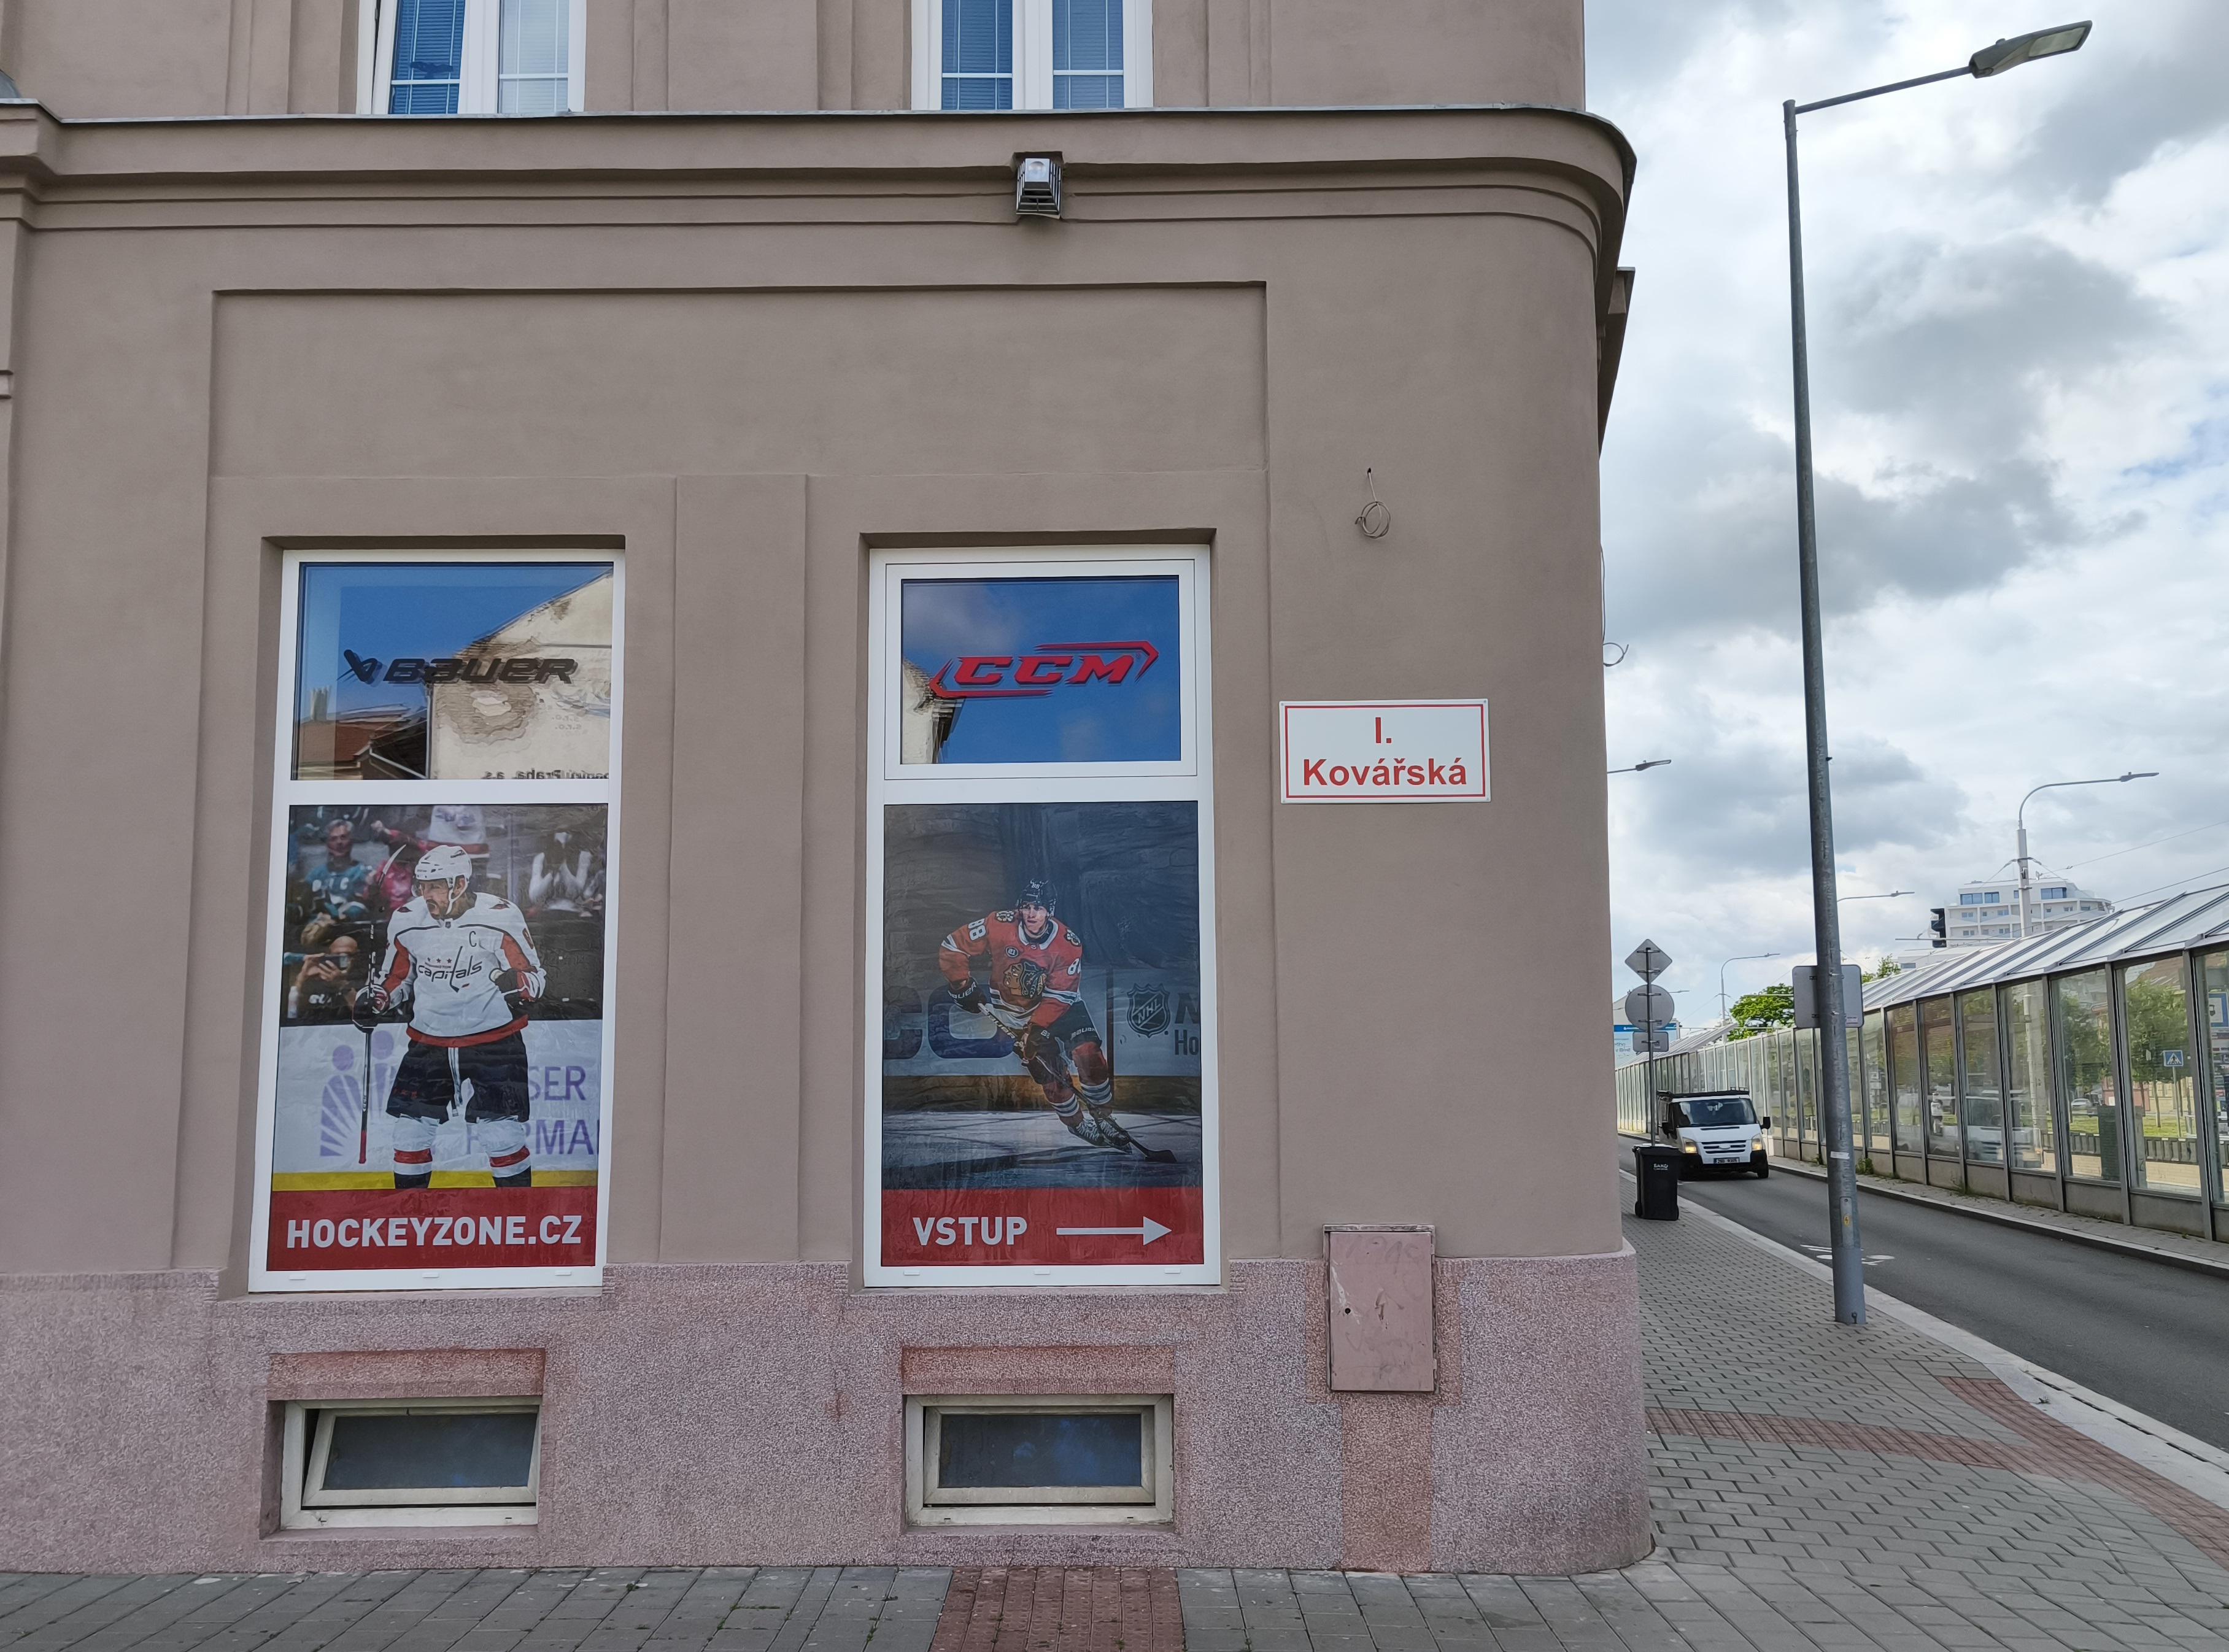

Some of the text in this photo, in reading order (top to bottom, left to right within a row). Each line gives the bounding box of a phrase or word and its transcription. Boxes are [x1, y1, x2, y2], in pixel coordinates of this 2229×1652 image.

[383, 657, 576, 684] BAUER
[953, 655, 1135, 685] CCM
[1375, 717, 1392, 744] I.
[1303, 757, 1467, 786] Kovářská
[468, 930, 477, 948] C
[1137, 998, 1161, 1024] NHL
[286, 1215, 582, 1248] HOCKEYZONE.CZ
[912, 1216, 1028, 1246] VSTUP
